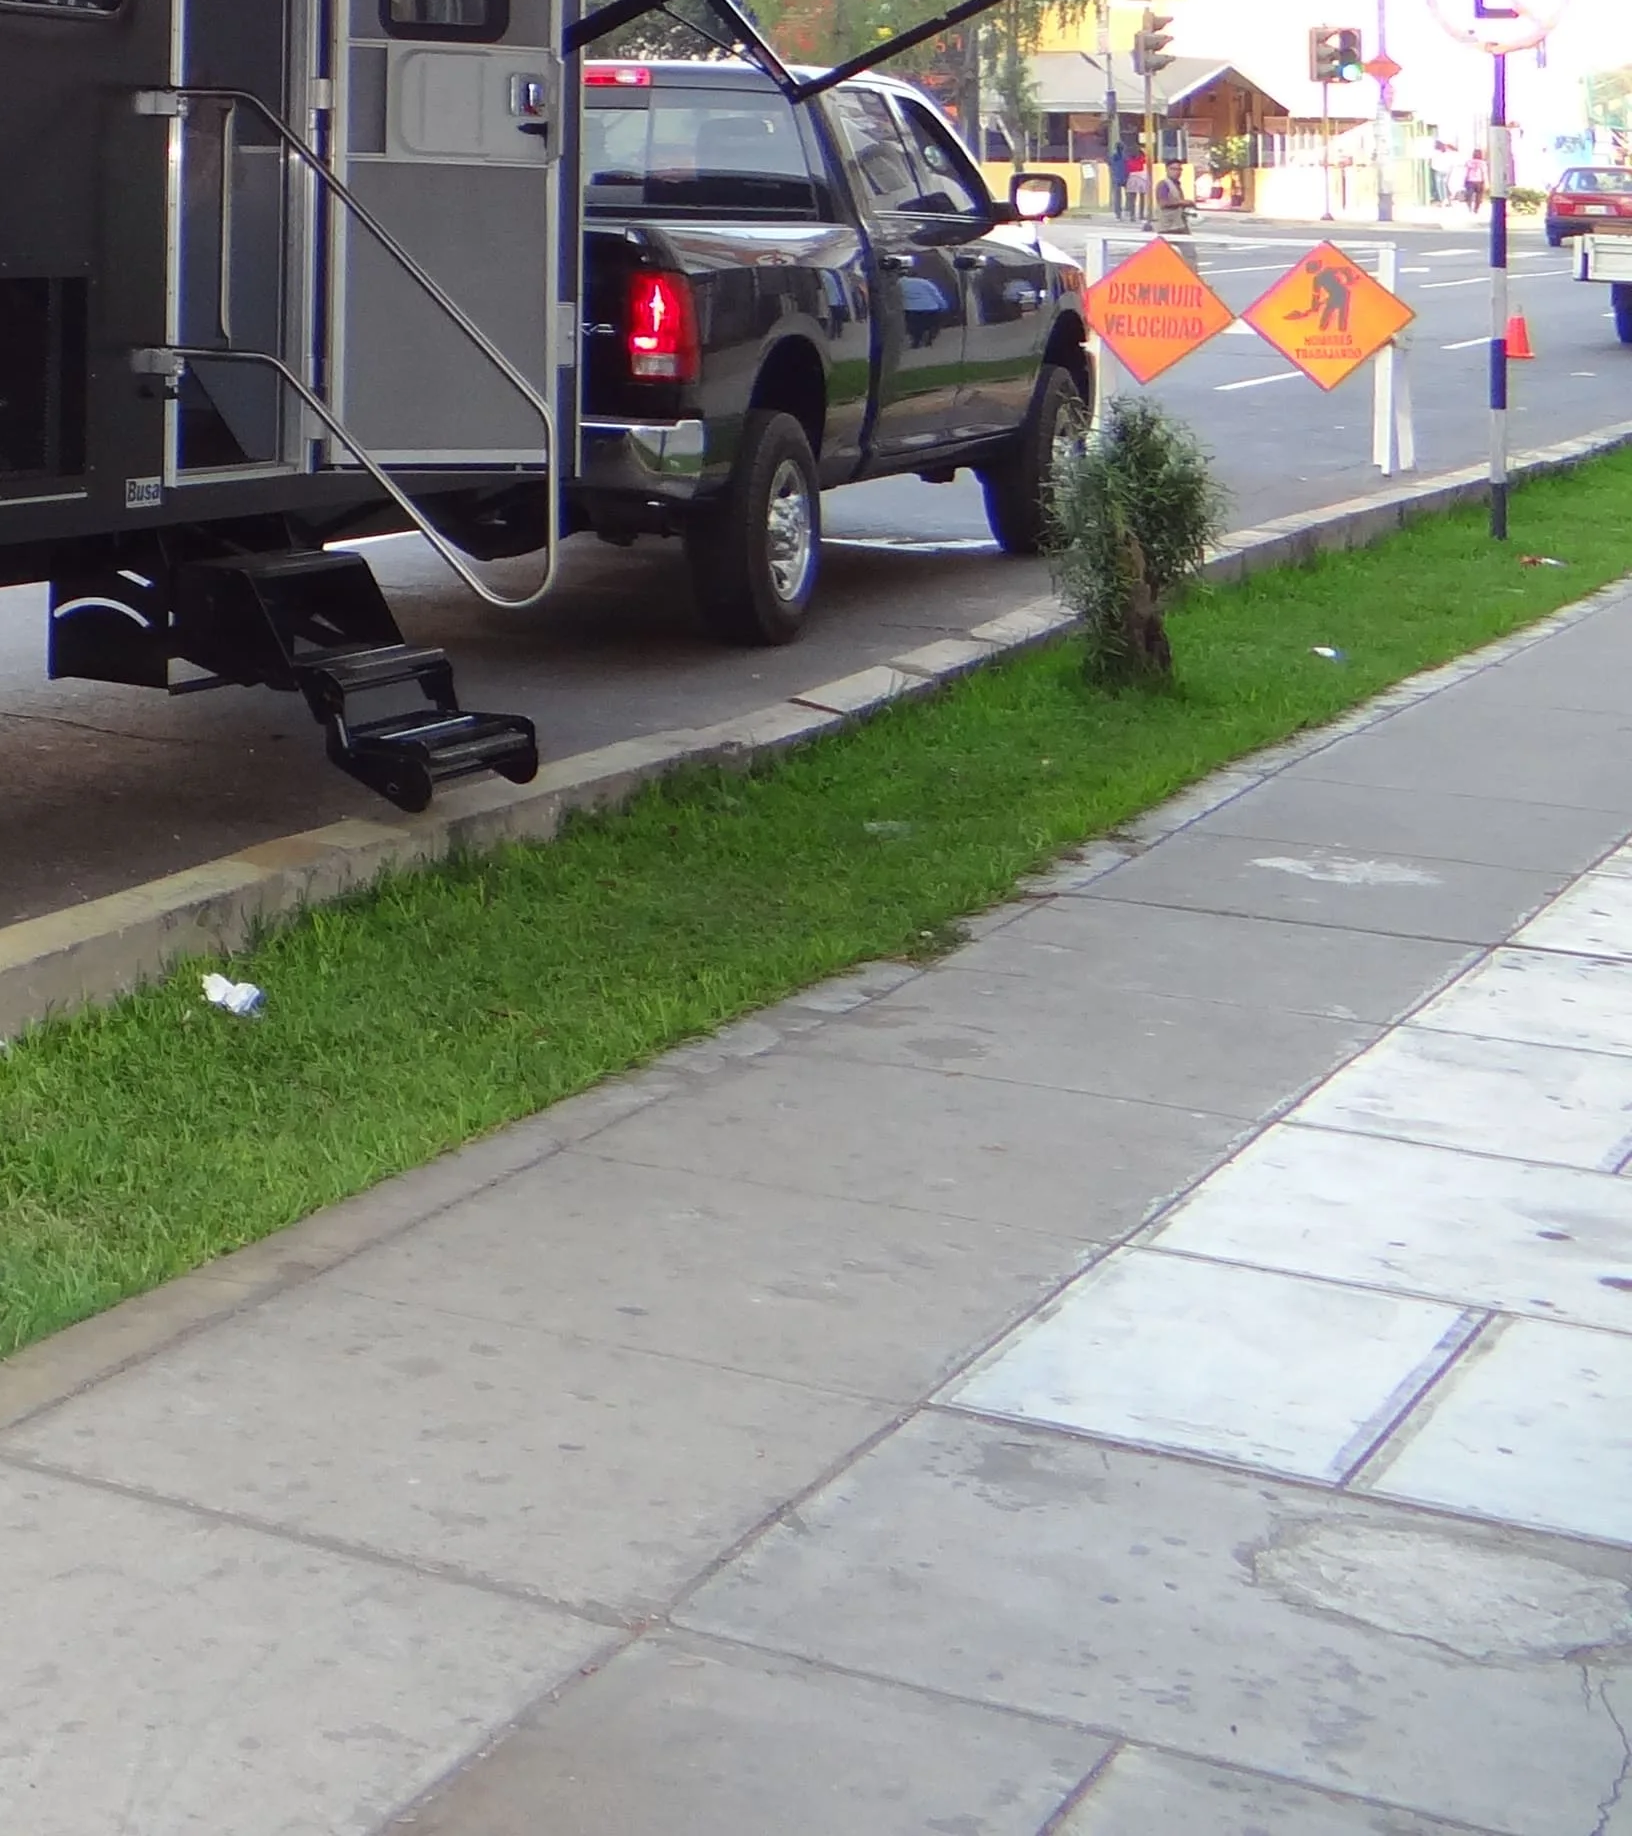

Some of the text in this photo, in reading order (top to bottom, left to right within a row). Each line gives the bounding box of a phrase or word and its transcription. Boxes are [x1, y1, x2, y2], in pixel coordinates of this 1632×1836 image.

[1107, 282, 1203, 308] DISMINUIR
[1103, 312, 1204, 340] VELOCIDAD
[127, 480, 160, 502] Busa
